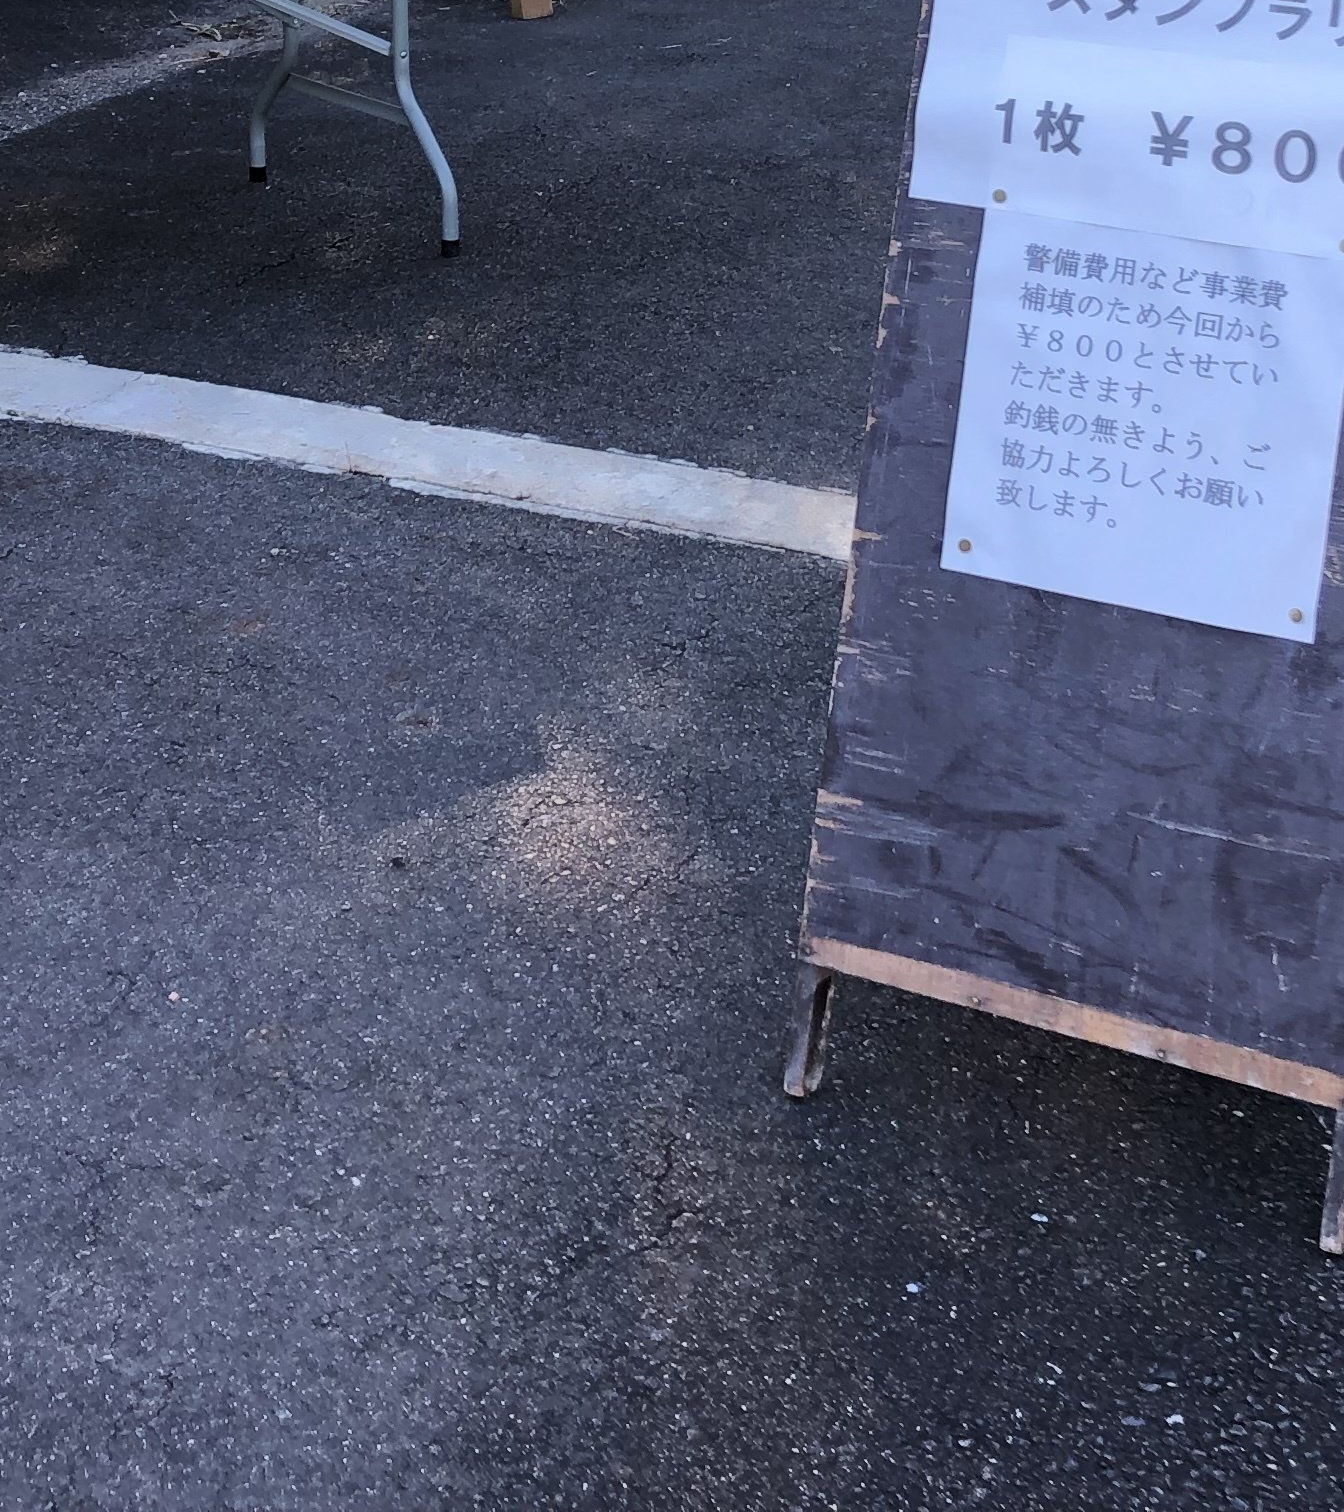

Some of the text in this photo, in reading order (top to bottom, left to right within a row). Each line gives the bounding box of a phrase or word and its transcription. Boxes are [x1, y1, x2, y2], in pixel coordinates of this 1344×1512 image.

[994, 97, 1085, 157] 1枚
[1023, 242, 1289, 312] 警備費用など事業費
[1018, 281, 1281, 349] 補填のため今回から
[1009, 360, 1162, 414] ただきます。
[996, 478, 1118, 529] 致します。
[1000, 436, 1266, 509] 協力よろしくお願い
